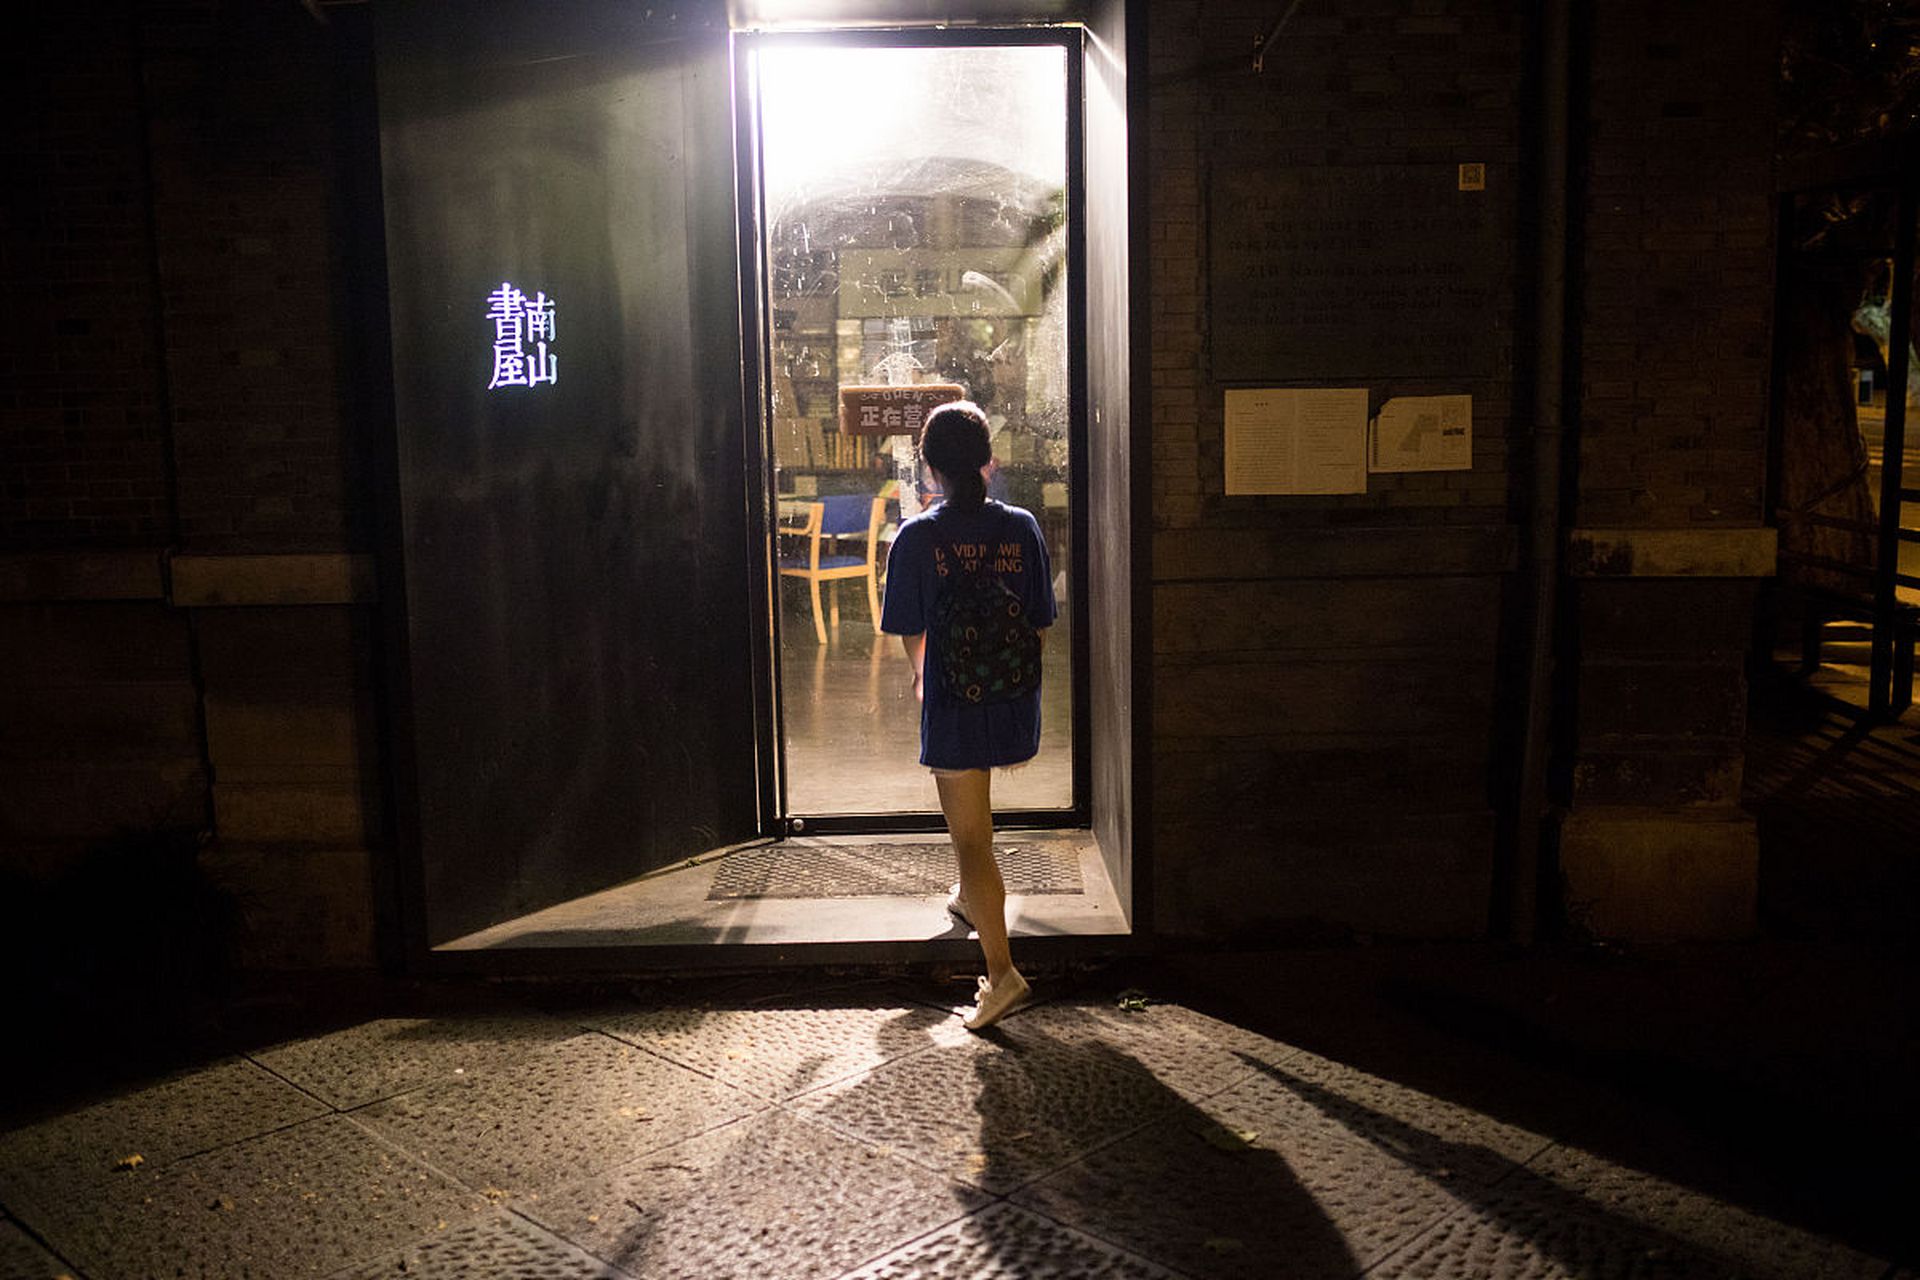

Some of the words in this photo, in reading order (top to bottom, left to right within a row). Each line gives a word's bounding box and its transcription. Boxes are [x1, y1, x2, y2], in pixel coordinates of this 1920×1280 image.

[485, 282, 528, 390] 書屋
[525, 291, 558, 388] 南山
[860, 404, 931, 428] 正在营
[934, 543, 977, 561] DVID
